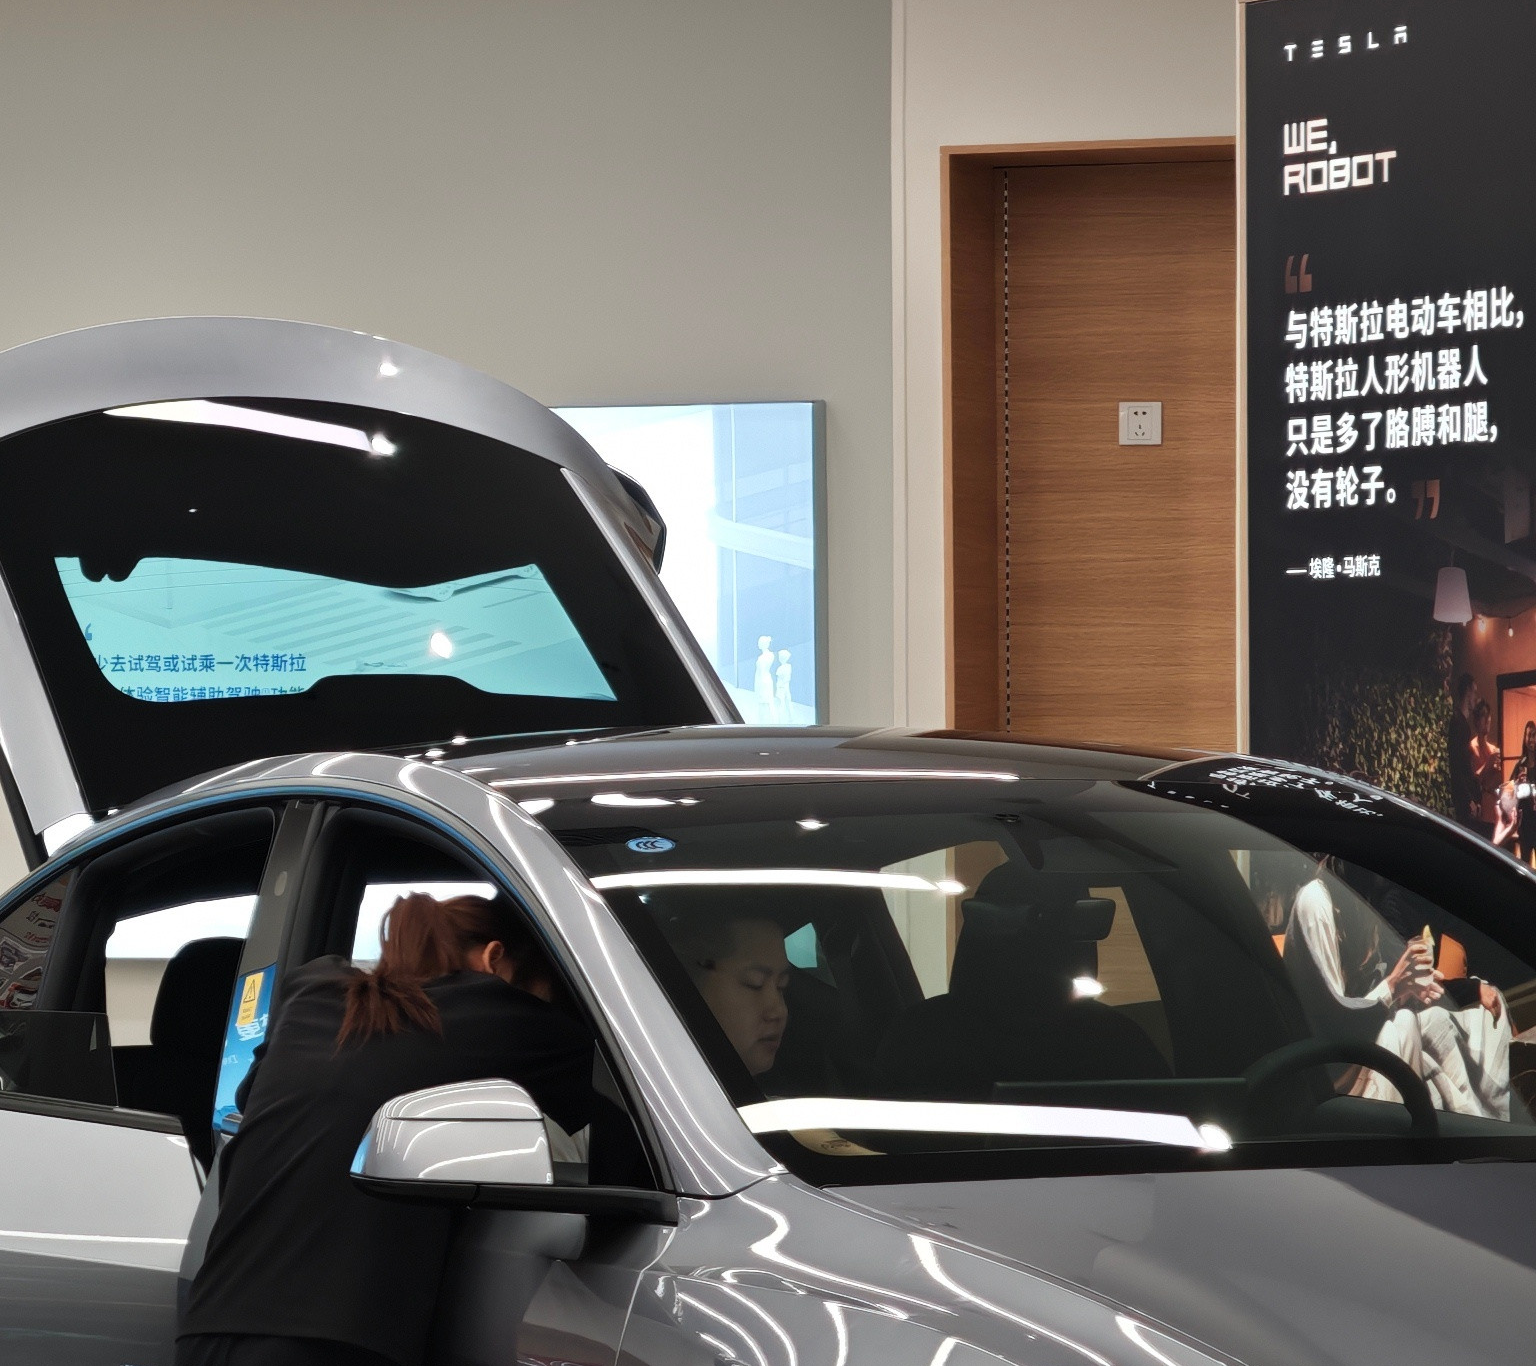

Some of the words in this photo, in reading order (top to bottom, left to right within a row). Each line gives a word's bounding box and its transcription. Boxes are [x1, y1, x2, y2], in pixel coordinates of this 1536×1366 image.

[1283, 25, 1408, 62] TESLA
[1283, 118, 1337, 155] WE,
[1283, 150, 1397, 196] ROBOT
[1284, 286, 1524, 350] 与特斯拉电动车相比，
[1285, 344, 1488, 404] 特斯拉人形机器人
[1286, 401, 1498, 457] 只是多了胳膊和腿，
[1286, 465, 1396, 510] 没有轮子。
